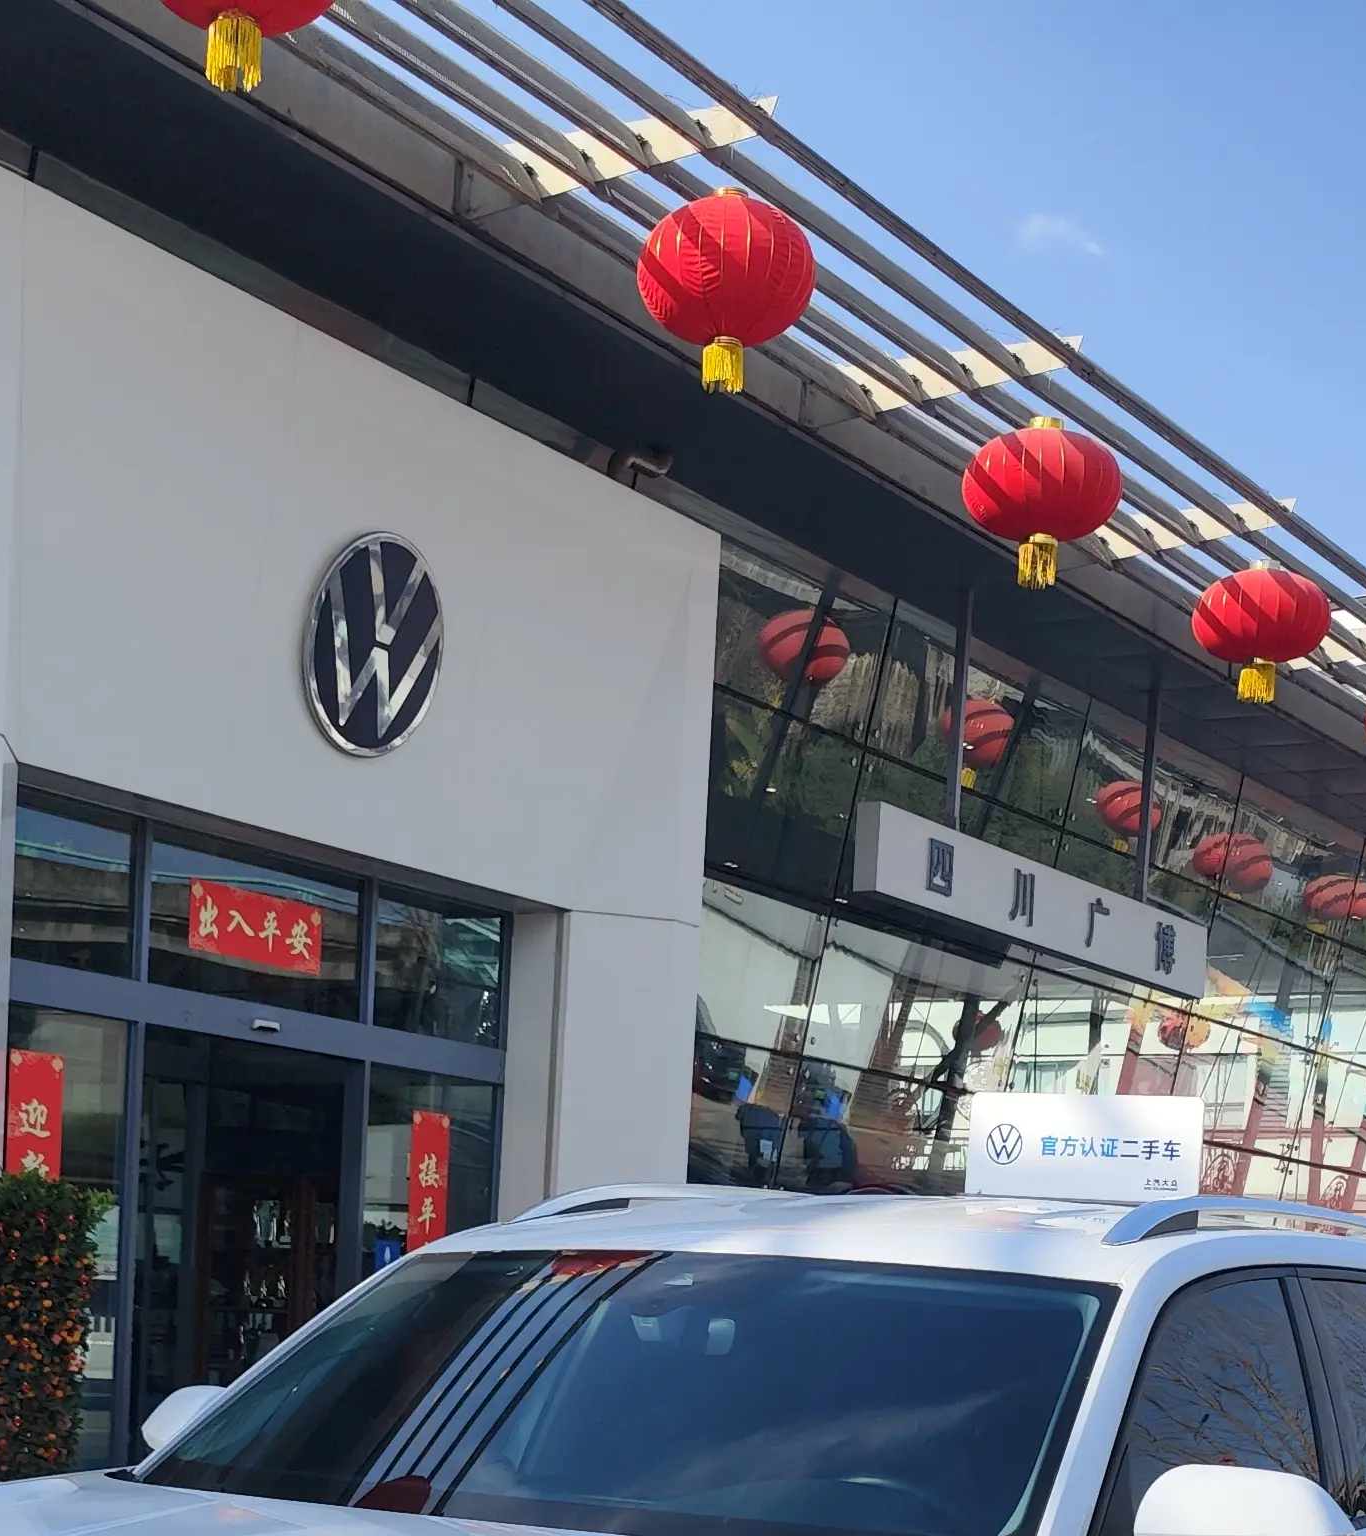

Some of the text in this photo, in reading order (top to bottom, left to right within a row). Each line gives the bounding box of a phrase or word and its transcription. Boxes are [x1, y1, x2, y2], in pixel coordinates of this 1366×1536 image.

[198, 895, 314, 960] 出入平安
[926, 837, 1176, 975] 四川广博
[1040, 1136, 1182, 1161] 官方认证二手车
[417, 1153, 441, 1245] 接平
